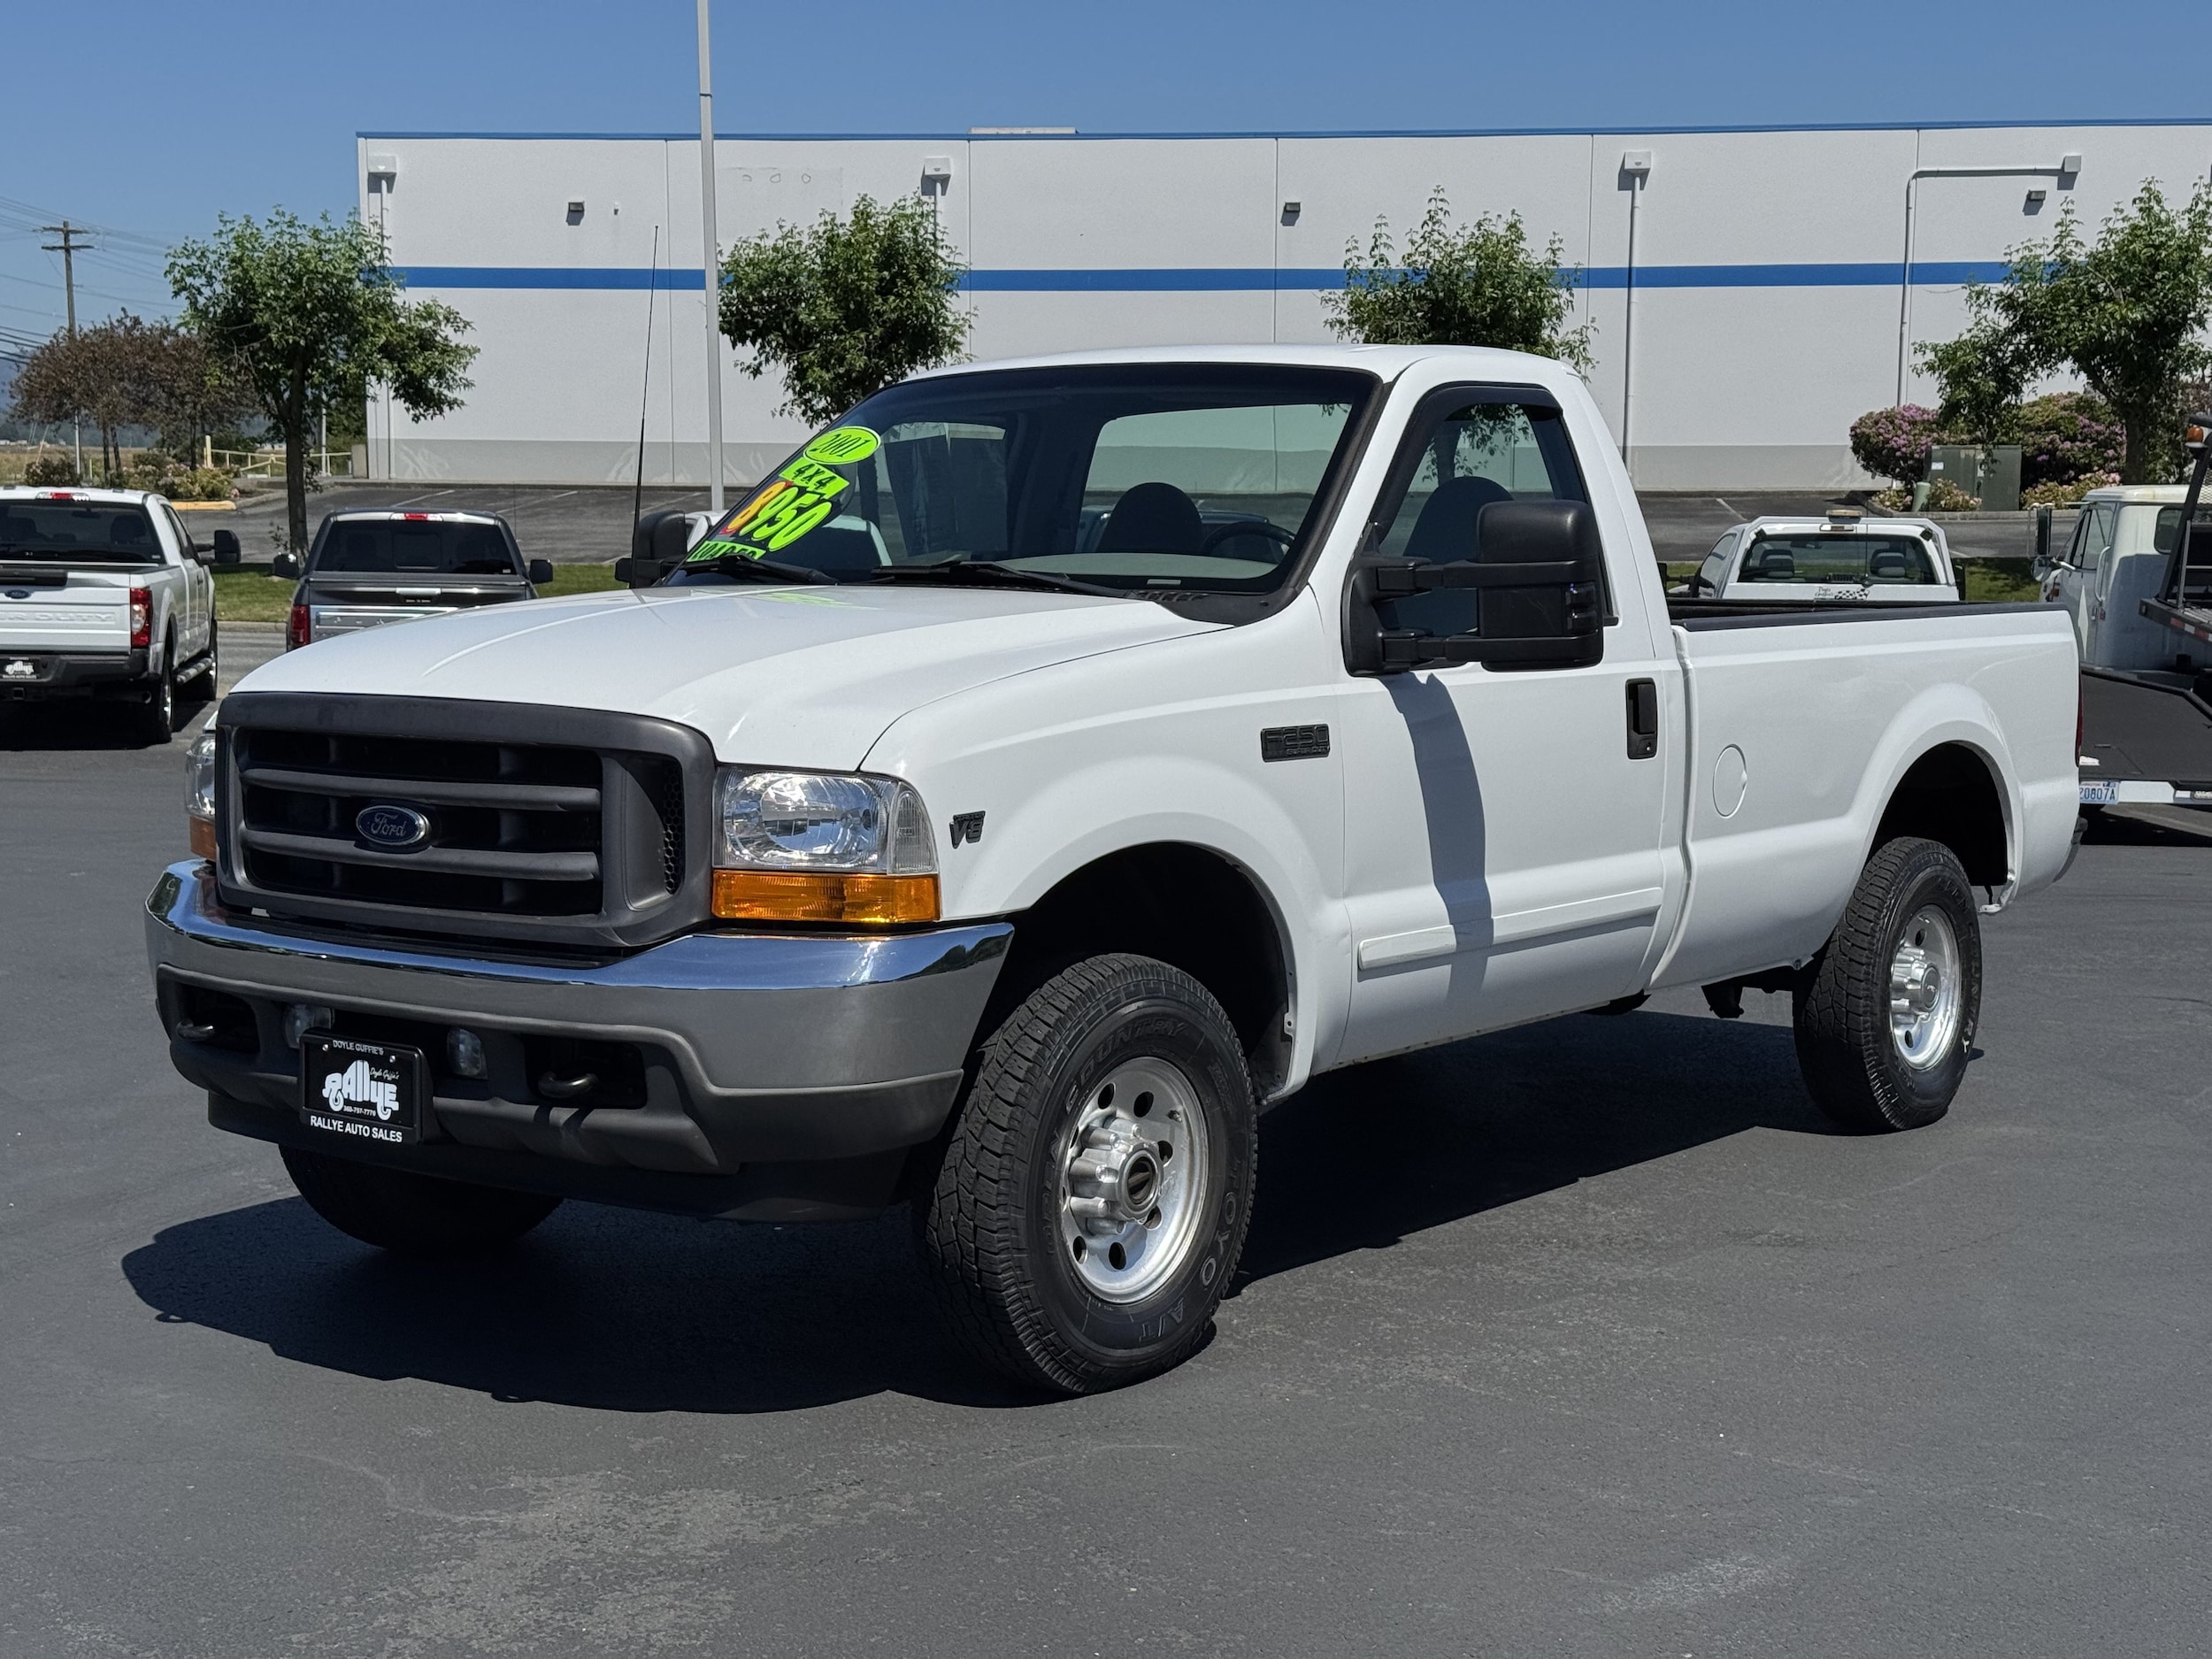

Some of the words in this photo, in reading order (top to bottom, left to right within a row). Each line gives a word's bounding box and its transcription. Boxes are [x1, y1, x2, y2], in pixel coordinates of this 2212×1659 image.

[726, 480, 833, 553] 8950
[371, 812, 407, 836] Ford
[949, 819, 984, 849] V8
[333, 1040, 355, 1051] DOYLE
[310, 1115, 343, 1133] RALLYE
[345, 1124, 370, 1137] AUTO
[372, 1127, 403, 1142] SALES
